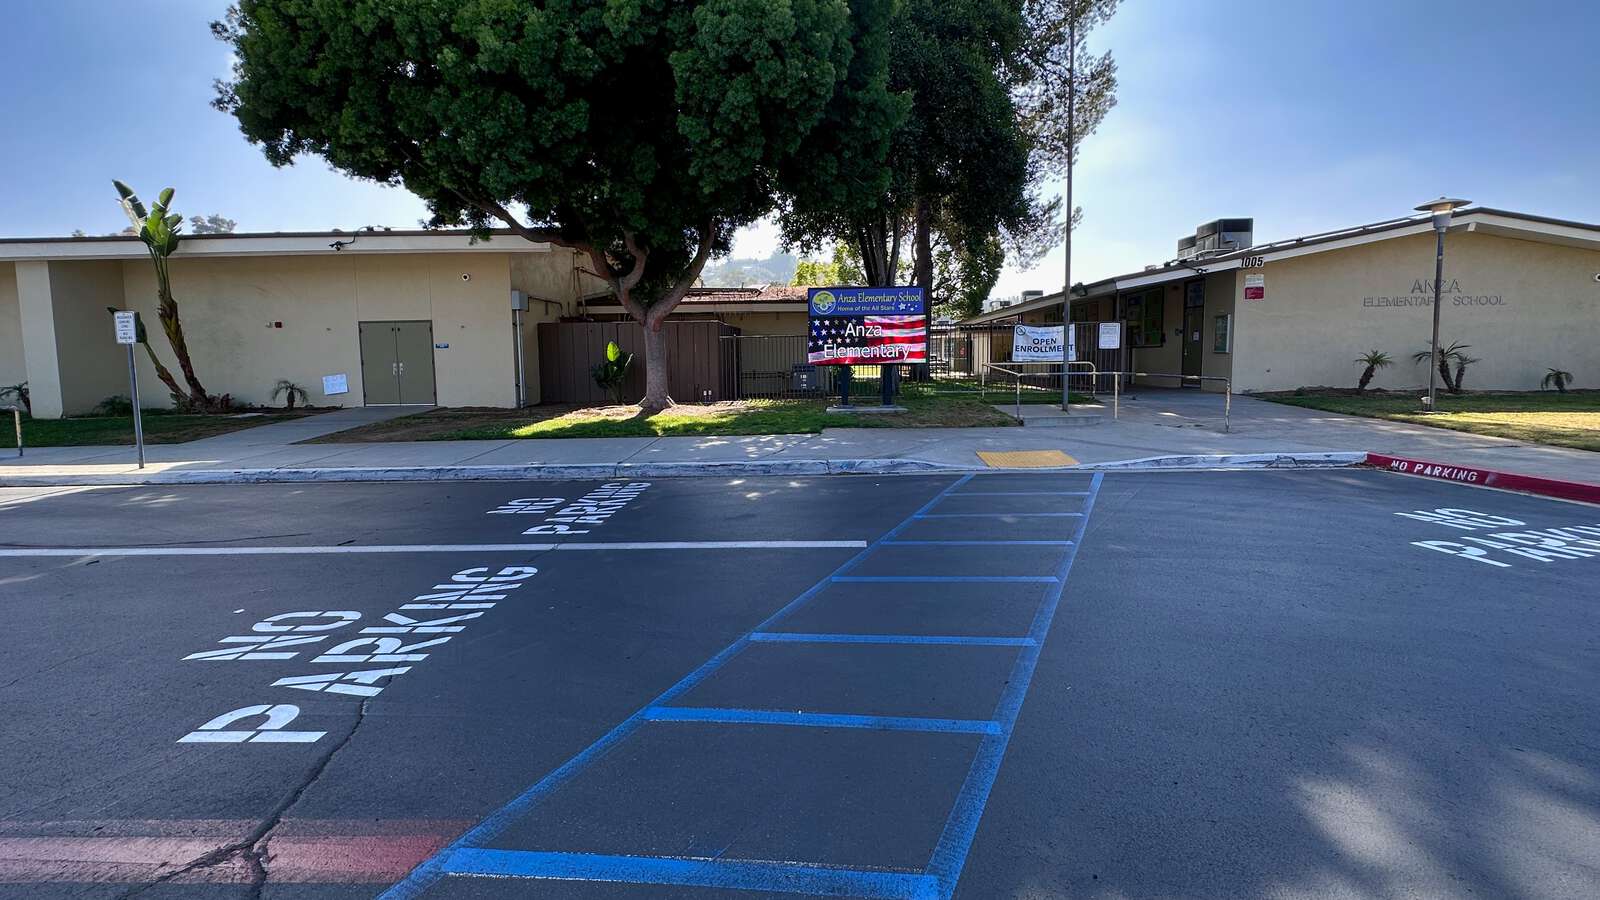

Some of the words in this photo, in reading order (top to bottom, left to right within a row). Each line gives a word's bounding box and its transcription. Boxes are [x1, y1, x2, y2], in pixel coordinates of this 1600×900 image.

[1241, 257, 1264, 268] 1005
[838, 292, 856, 303] Anza
[858, 291, 897, 306] Elementary
[899, 290, 921, 302] School
[1452, 295, 1506, 306] SCHOOL
[844, 322, 882, 337] Anza
[824, 343, 912, 361] Elementary
[1015, 344, 1074, 353] ENROLLMET
[1391, 460, 1408, 471] NO
[1414, 463, 1478, 482] PARKING
[486, 498, 566, 514] NO
[521, 483, 652, 535] PARKING
[1393, 508, 1528, 531] NO
[180, 610, 362, 661] NO
[176, 566, 539, 744] PARKING
